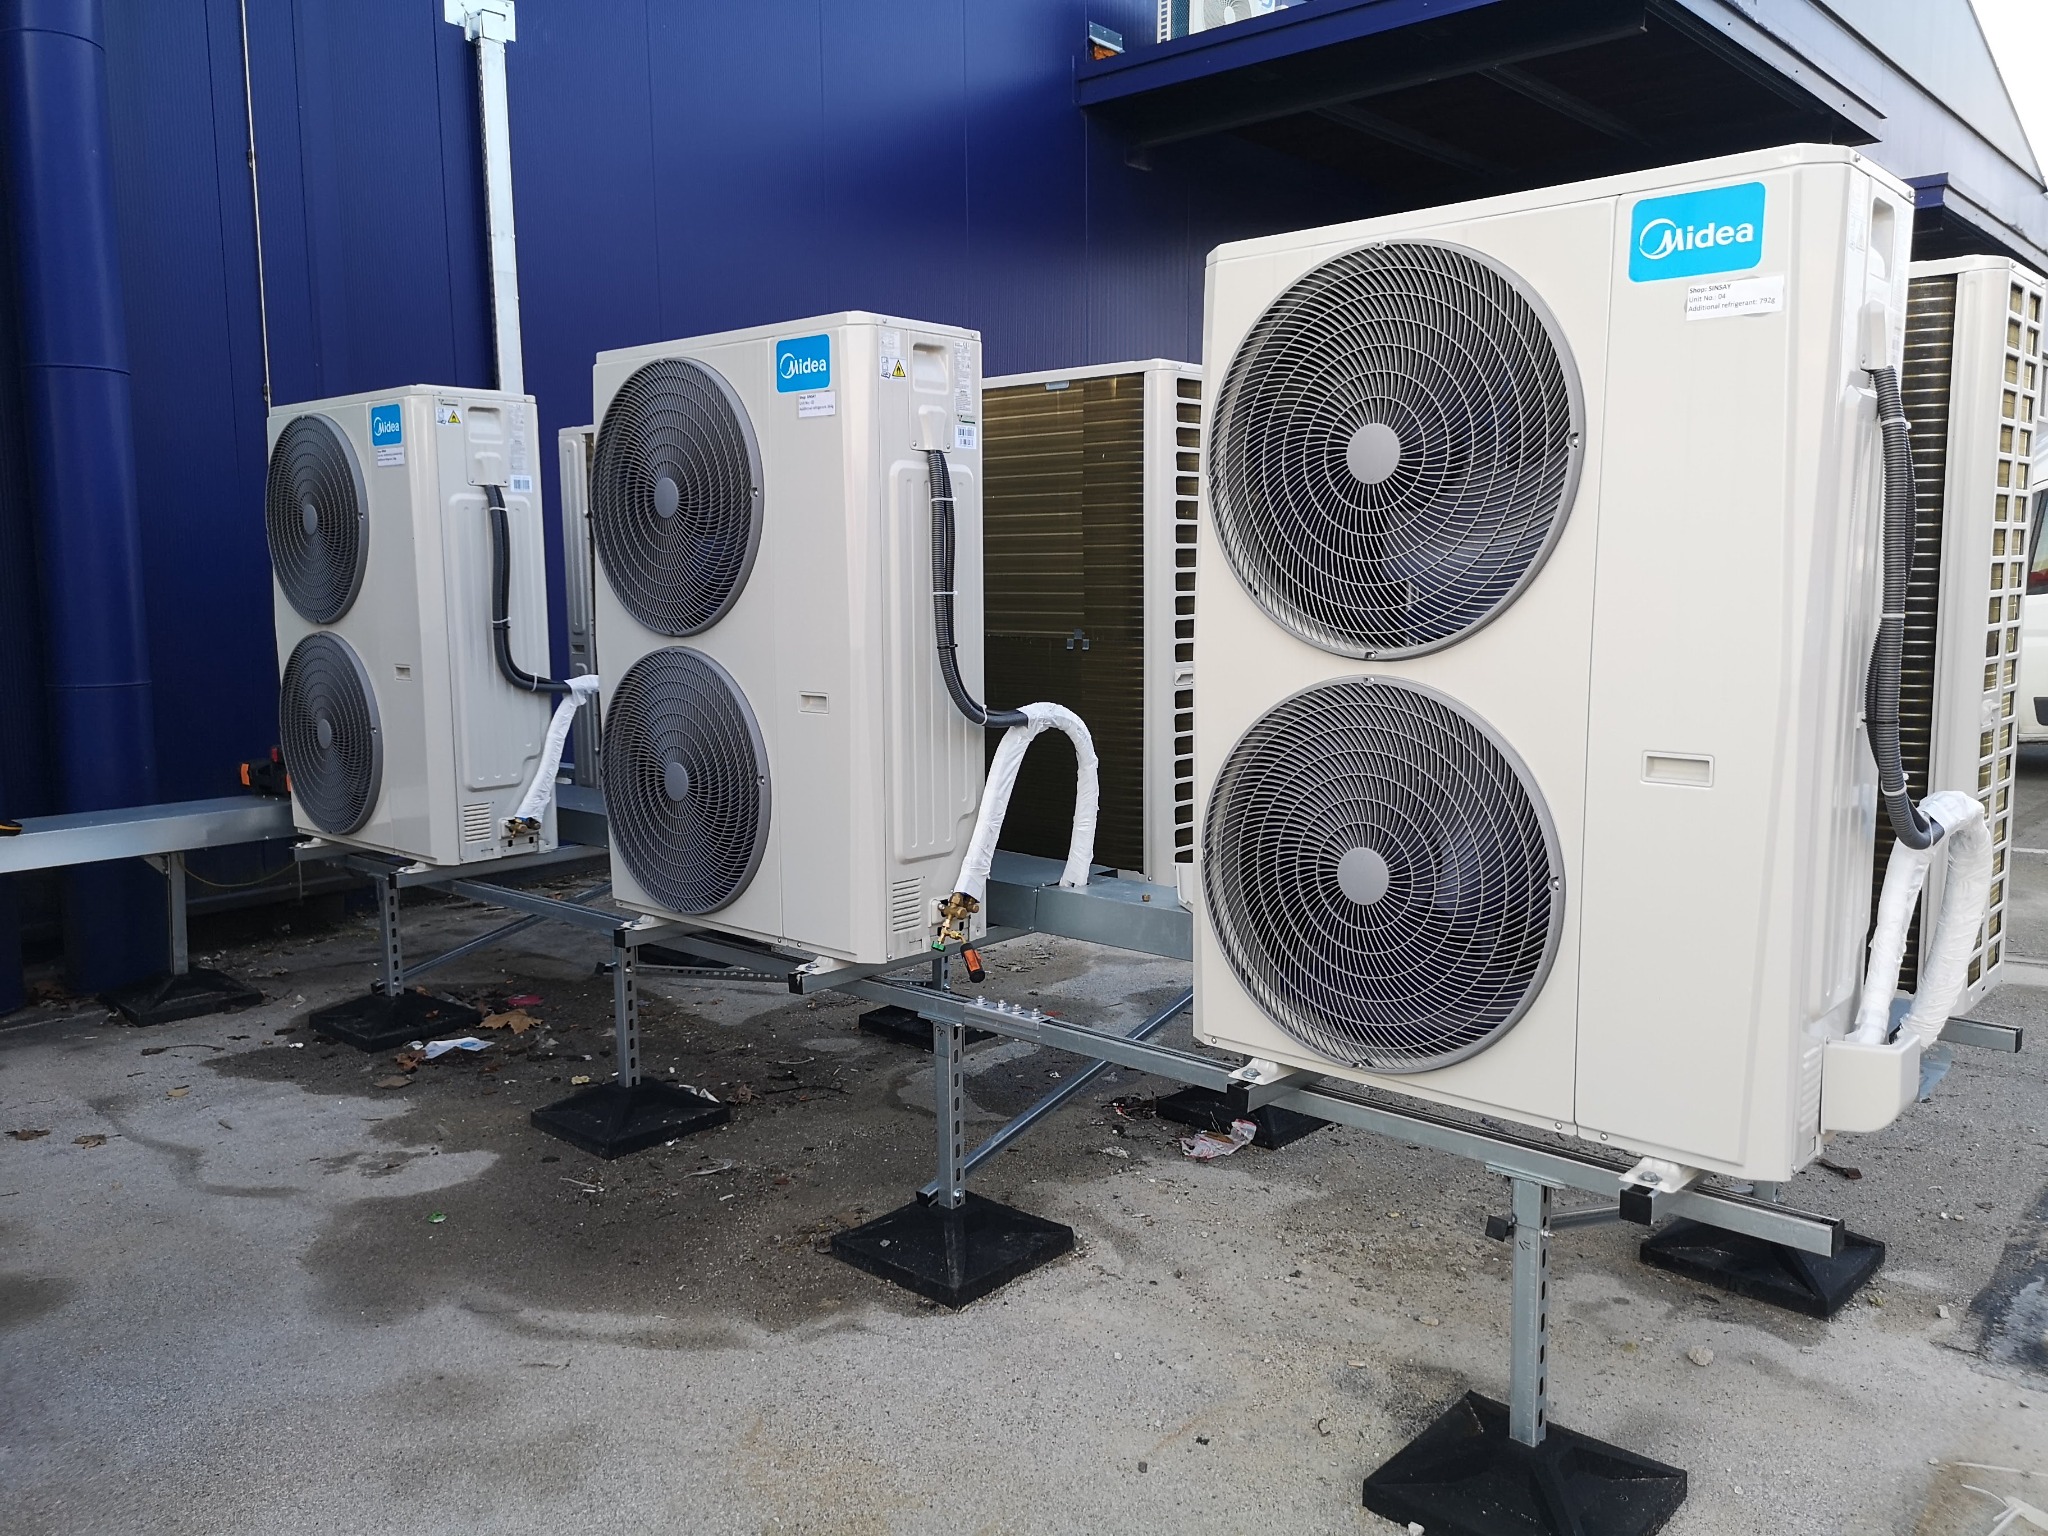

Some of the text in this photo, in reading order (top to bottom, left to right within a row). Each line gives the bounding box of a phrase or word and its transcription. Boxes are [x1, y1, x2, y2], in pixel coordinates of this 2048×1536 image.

[1639, 217, 1754, 260] Midea
[1708, 283, 1732, 291] SINSAY
[1688, 295, 1702, 303] Unit
[1688, 303, 1721, 312] Additional
[1721, 299, 1758, 309] refrigerant:
[780, 352, 827, 379] Midea
[373, 416, 400, 437] Midea
